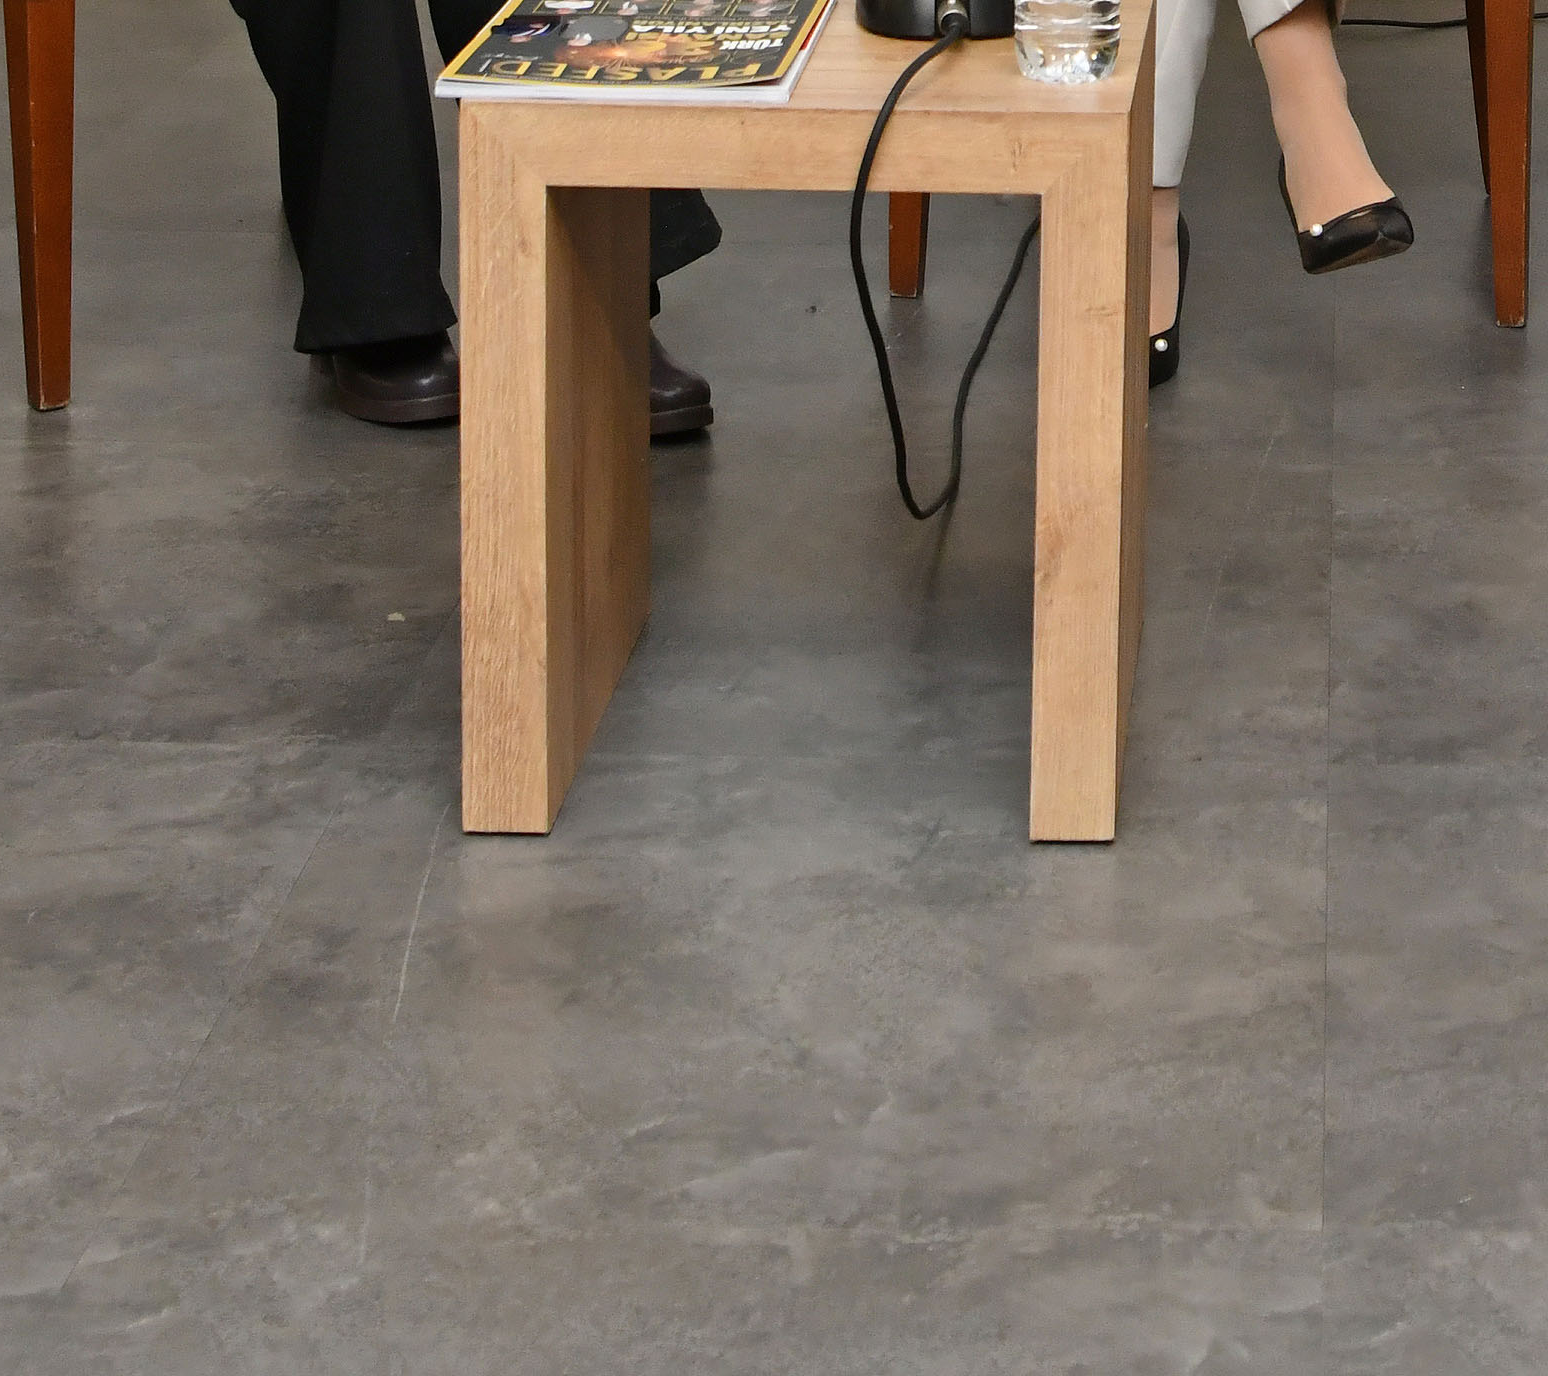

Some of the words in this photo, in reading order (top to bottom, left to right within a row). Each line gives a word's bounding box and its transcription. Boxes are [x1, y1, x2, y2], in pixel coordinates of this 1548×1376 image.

[712, 24, 792, 35] YENİ
[720, 38, 784, 50] TÜRK
[492, 60, 762, 81] PLASFED
